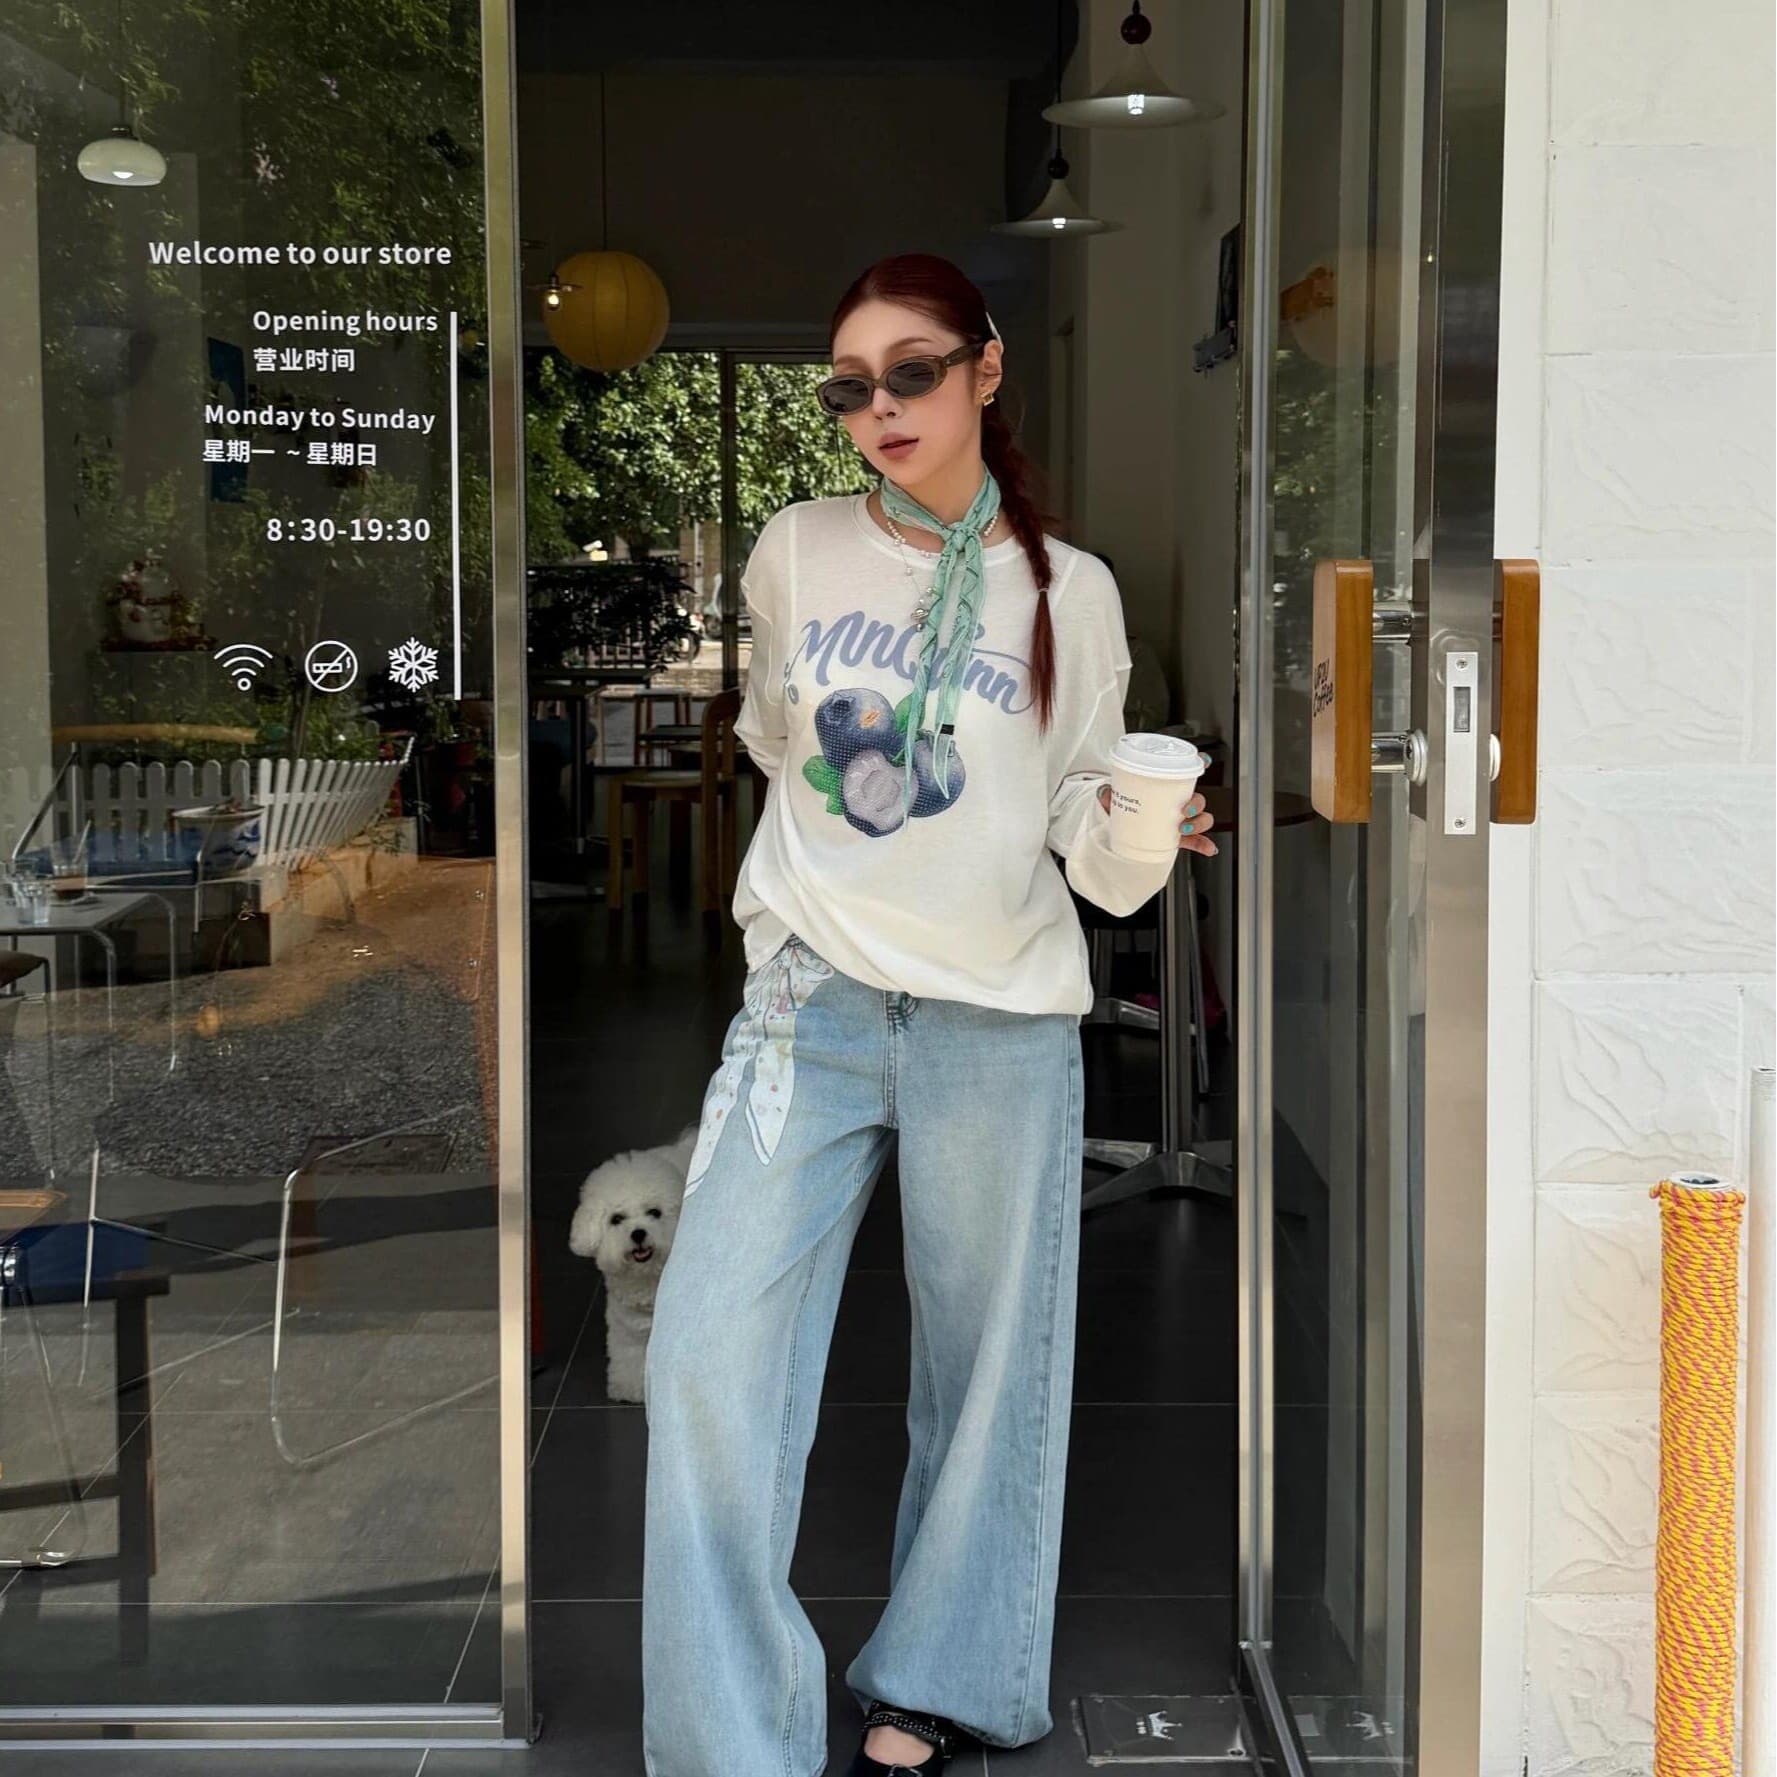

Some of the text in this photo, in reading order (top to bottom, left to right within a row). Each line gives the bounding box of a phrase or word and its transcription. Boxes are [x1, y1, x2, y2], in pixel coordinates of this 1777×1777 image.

[148, 240, 452, 265] Welcome to our store
[253, 308, 438, 337] Opening hours
[253, 347, 355, 372] 营业时间
[205, 404, 436, 435] Monday to Sunday
[202, 439, 275, 463] 星期一
[306, 442, 377, 466] 星期日
[267, 518, 431, 542] 8:30-19:30
